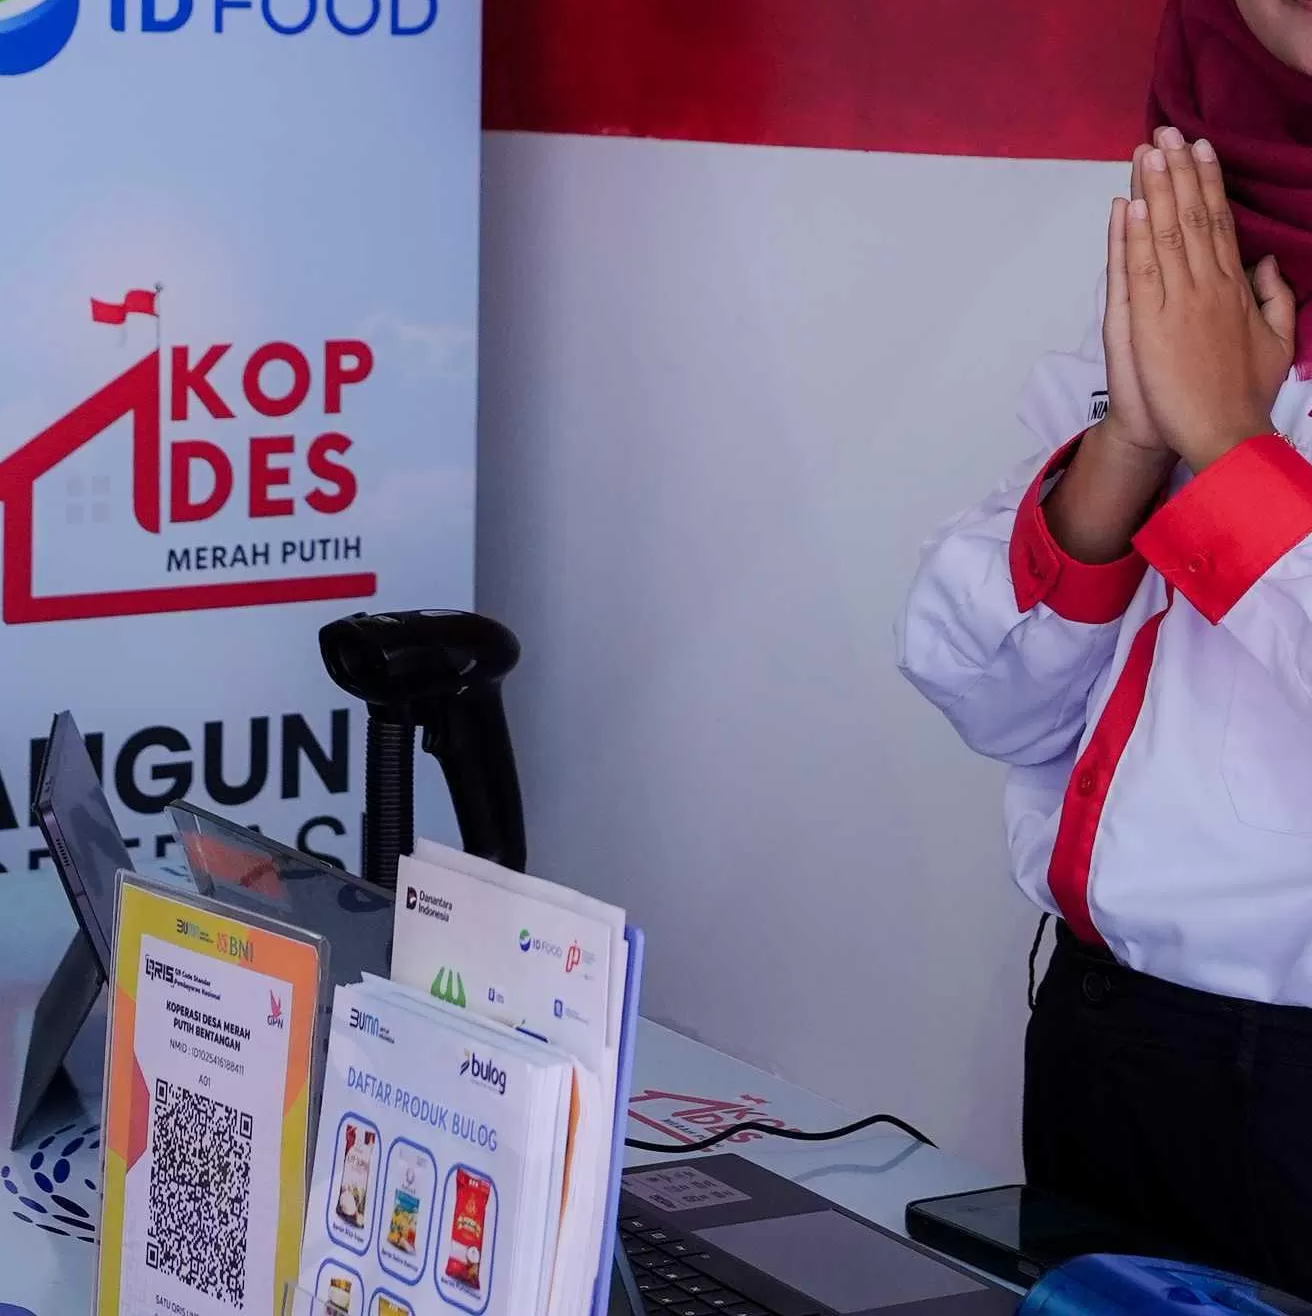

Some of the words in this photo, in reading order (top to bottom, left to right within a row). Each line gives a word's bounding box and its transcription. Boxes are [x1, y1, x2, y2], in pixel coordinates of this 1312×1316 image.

[170, 338, 374, 421] KOP
[169, 431, 359, 523] DES
[166, 540, 271, 573] MERAH
[281, 536, 363, 568] PUTIH
[419, 889, 453, 911] Danantara
[229, 935, 255, 963] BNI
[166, 999, 202, 1023] KOPERASI
[202, 1013, 222, 1030] DESA
[223, 1019, 252, 1041] MERAH
[173, 1017, 195, 1035] PUTIH
[195, 1025, 241, 1052] BENTANGAN
[267, 1015, 284, 1029] GPN
[169, 1038, 188, 1053] NMID
[471, 1051, 507, 1095] bulog
[347, 1066, 392, 1106] DAFTAR
[394, 1088, 448, 1132] PRODUK
[451, 1112, 497, 1152] BULOG
